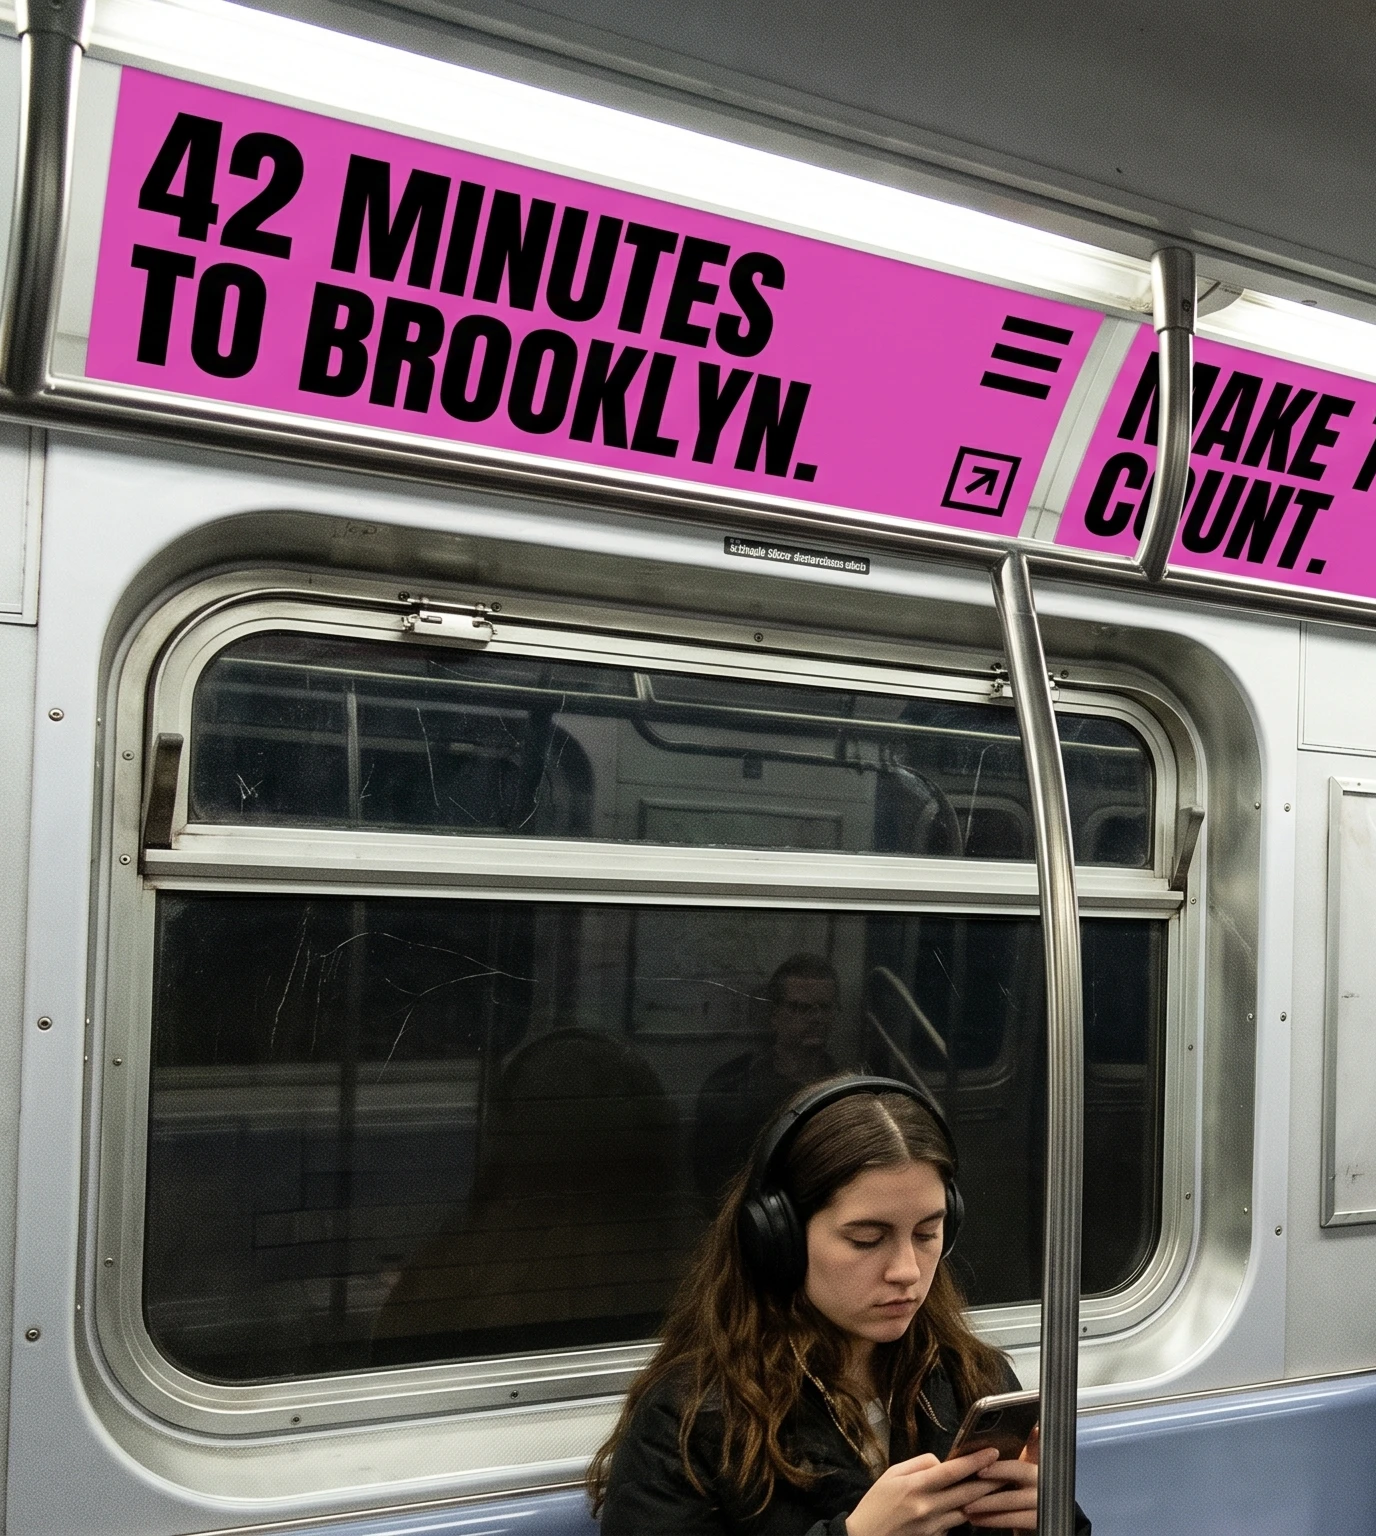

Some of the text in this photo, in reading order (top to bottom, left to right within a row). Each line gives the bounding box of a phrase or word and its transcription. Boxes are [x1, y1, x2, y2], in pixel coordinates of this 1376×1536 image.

[139, 113, 785, 357] 42 MINUTES
[132, 245, 818, 482] TO BROOKLYN.
